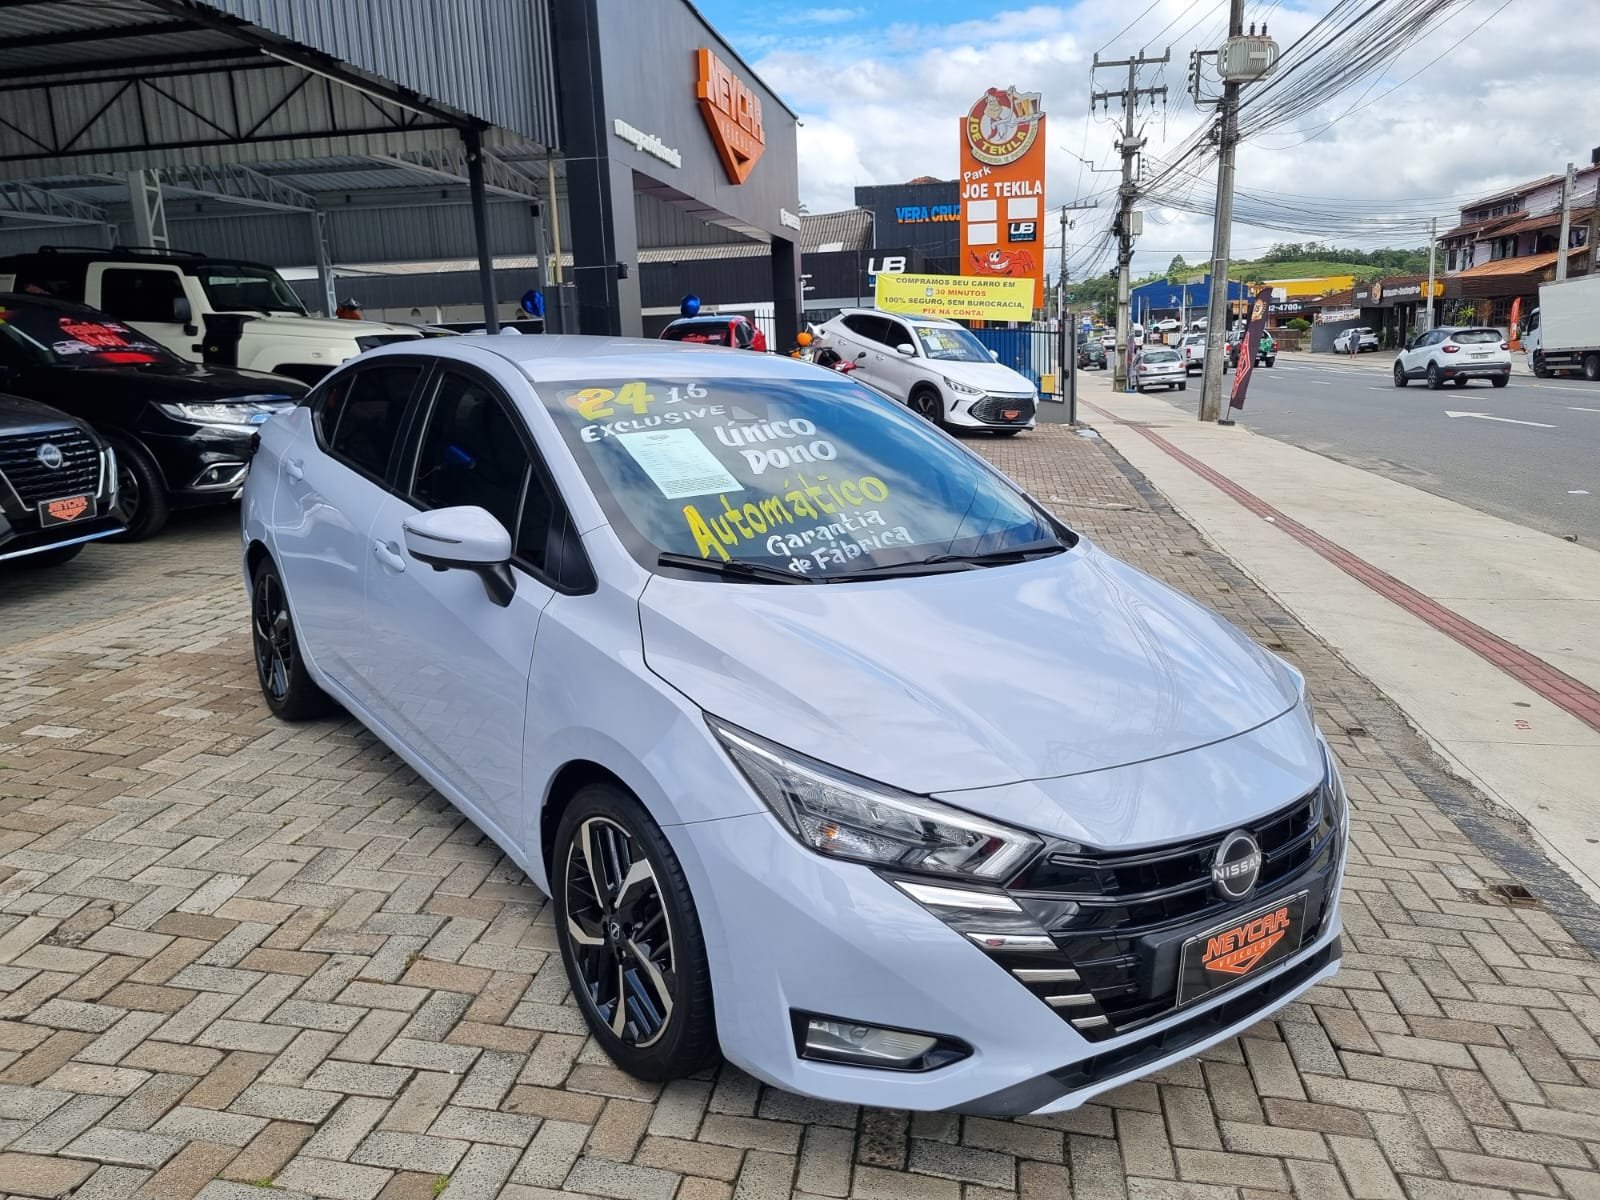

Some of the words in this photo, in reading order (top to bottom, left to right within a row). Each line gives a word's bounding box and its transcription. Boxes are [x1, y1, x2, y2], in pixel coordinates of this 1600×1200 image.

[969, 117, 981, 143] JOE
[982, 131, 1027, 155] TEKILA
[962, 183, 989, 199] JOE
[994, 180, 1043, 197] TEKILA
[963, 166, 992, 183] Park
[895, 206, 929, 223] VERA
[896, 277, 949, 286] COMPRAMOS
[971, 280, 1000, 288] CARRO
[948, 289, 986, 297] MINUTOS
[908, 298, 945, 306] SEGURO,
[967, 301, 1025, 309] BUROCRACIA,
[577, 382, 656, 421] 24
[664, 383, 708, 404] 1.6
[580, 405, 726, 443] EXCLUSIVE
[683, 474, 889, 562] Automático
[767, 510, 887, 557] Garantia
[788, 557, 814, 573] de
[811, 526, 913, 570] Fábrica
[1212, 854, 1262, 881] NISSAN
[1202, 907, 1290, 963] NEYCAR
